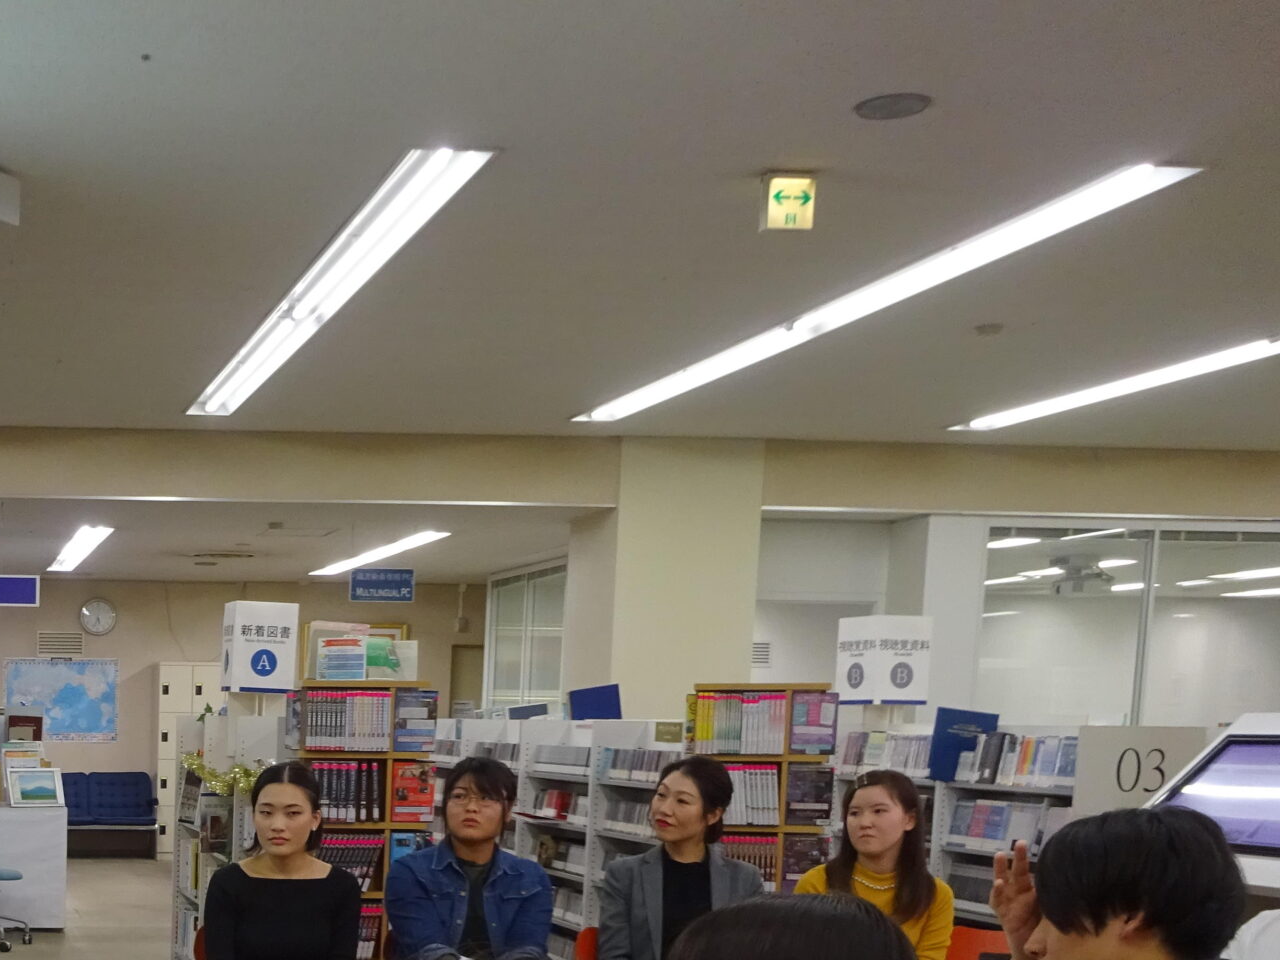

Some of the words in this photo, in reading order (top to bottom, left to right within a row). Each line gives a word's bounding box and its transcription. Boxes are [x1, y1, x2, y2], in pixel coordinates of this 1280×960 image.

[240, 624, 292, 639] 新着図書
[257, 655, 271, 670] A
[850, 667, 861, 684] B
[895, 667, 909, 684] B
[1116, 747, 1167, 793] 03
